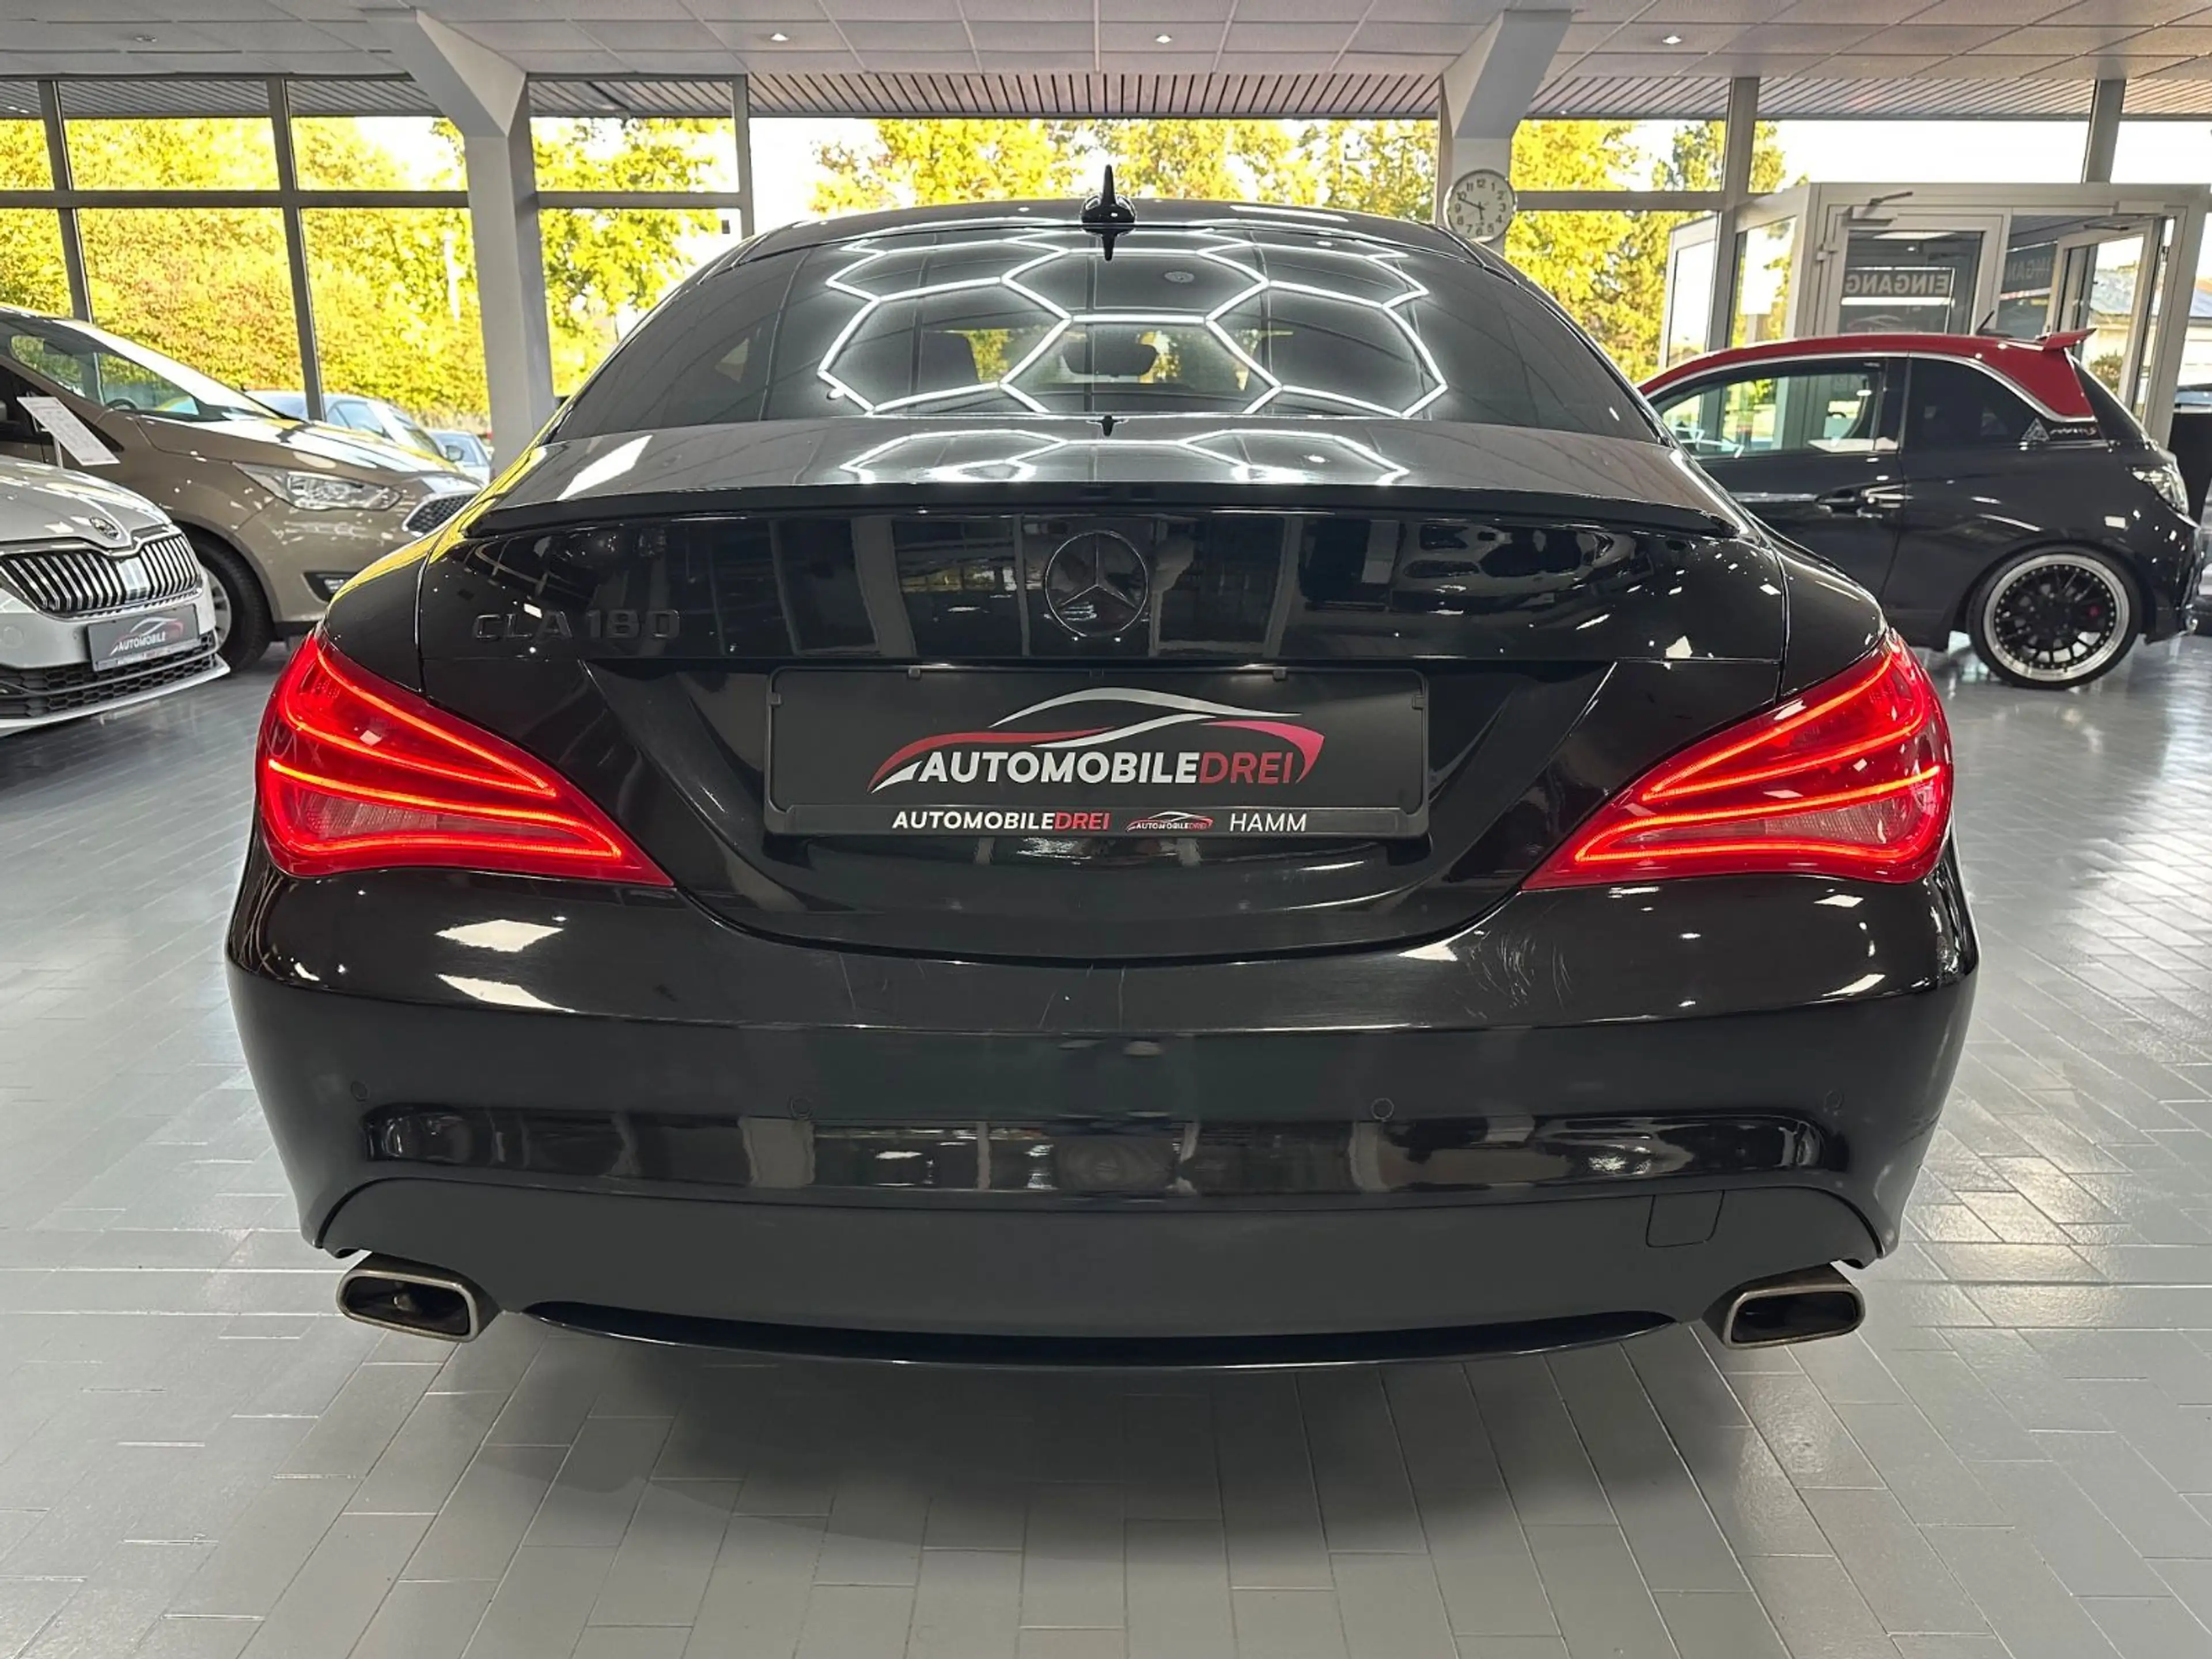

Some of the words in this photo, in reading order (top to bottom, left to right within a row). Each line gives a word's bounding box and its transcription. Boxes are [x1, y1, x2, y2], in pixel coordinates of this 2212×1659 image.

[1467, 182, 1474, 191] 11
[1476, 179, 1486, 188] 12
[1491, 183, 1495, 191] 1
[472, 609, 573, 639] CLA
[586, 609, 680, 639] 180
[918, 751, 1294, 784] AUTOMOBILEDREI
[892, 811, 1112, 830] AUTOMOBILEDREI
[1229, 813, 1308, 832] HAMM
